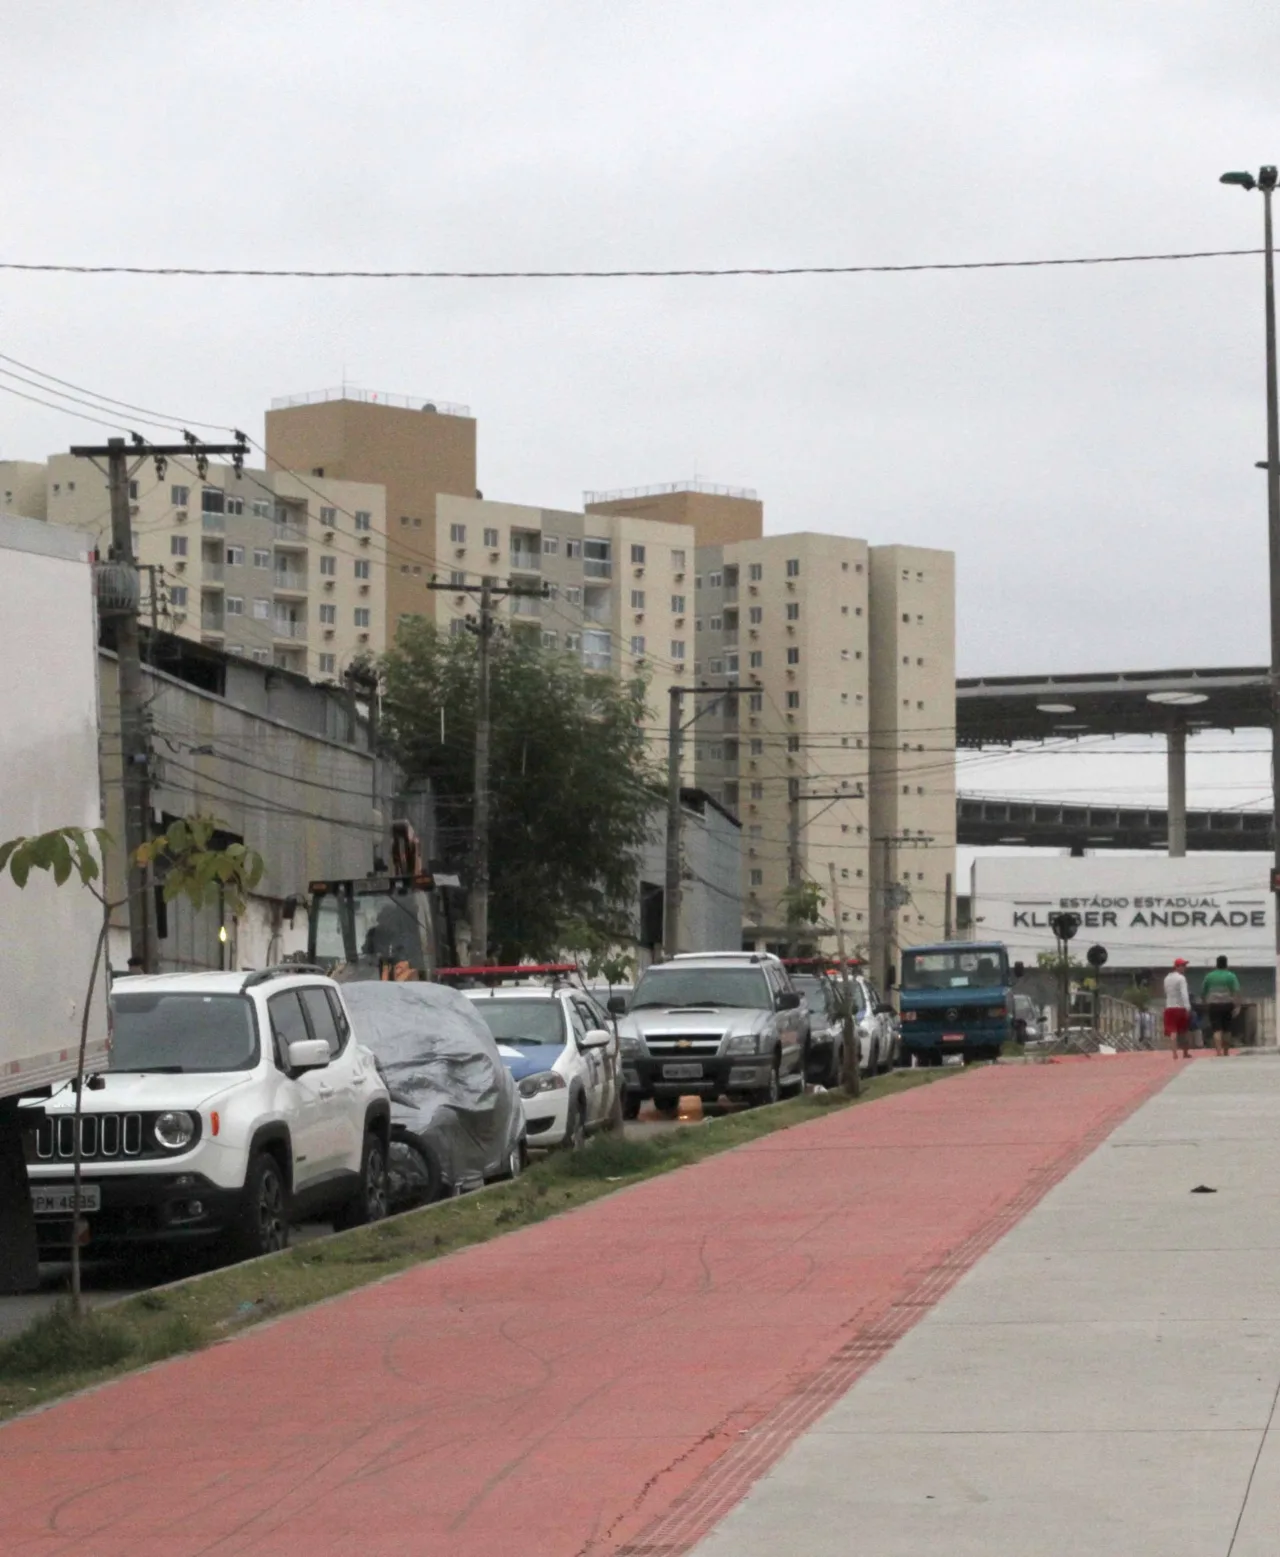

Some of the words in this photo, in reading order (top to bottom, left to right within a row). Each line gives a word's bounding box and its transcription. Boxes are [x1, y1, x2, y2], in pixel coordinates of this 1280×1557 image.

[1059, 894, 1129, 908] ESTÁDIO
[1133, 897, 1220, 908] ESTADUAL
[1129, 911, 1266, 928] ANDRADE
